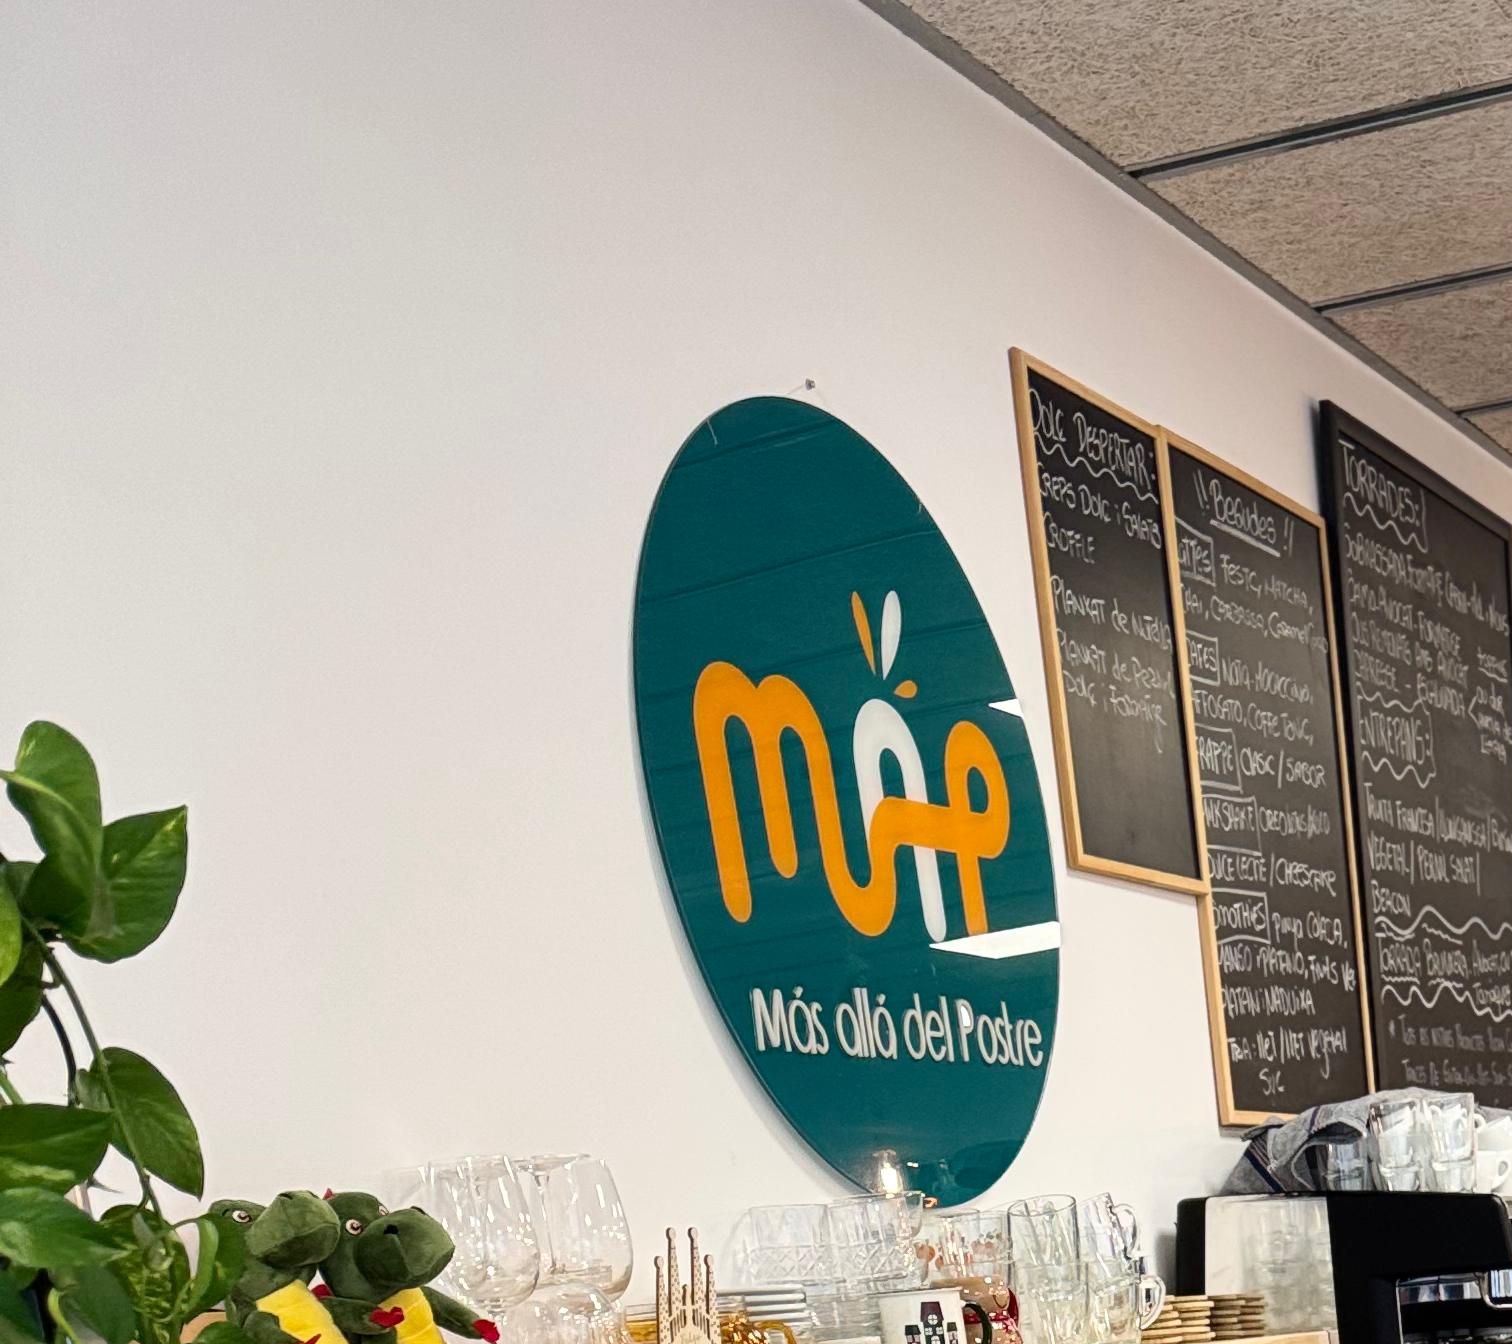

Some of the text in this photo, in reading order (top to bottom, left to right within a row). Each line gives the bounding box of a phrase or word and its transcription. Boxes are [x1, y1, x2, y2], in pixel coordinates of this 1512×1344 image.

[751, 986, 1045, 1069] Más allá del Postre
